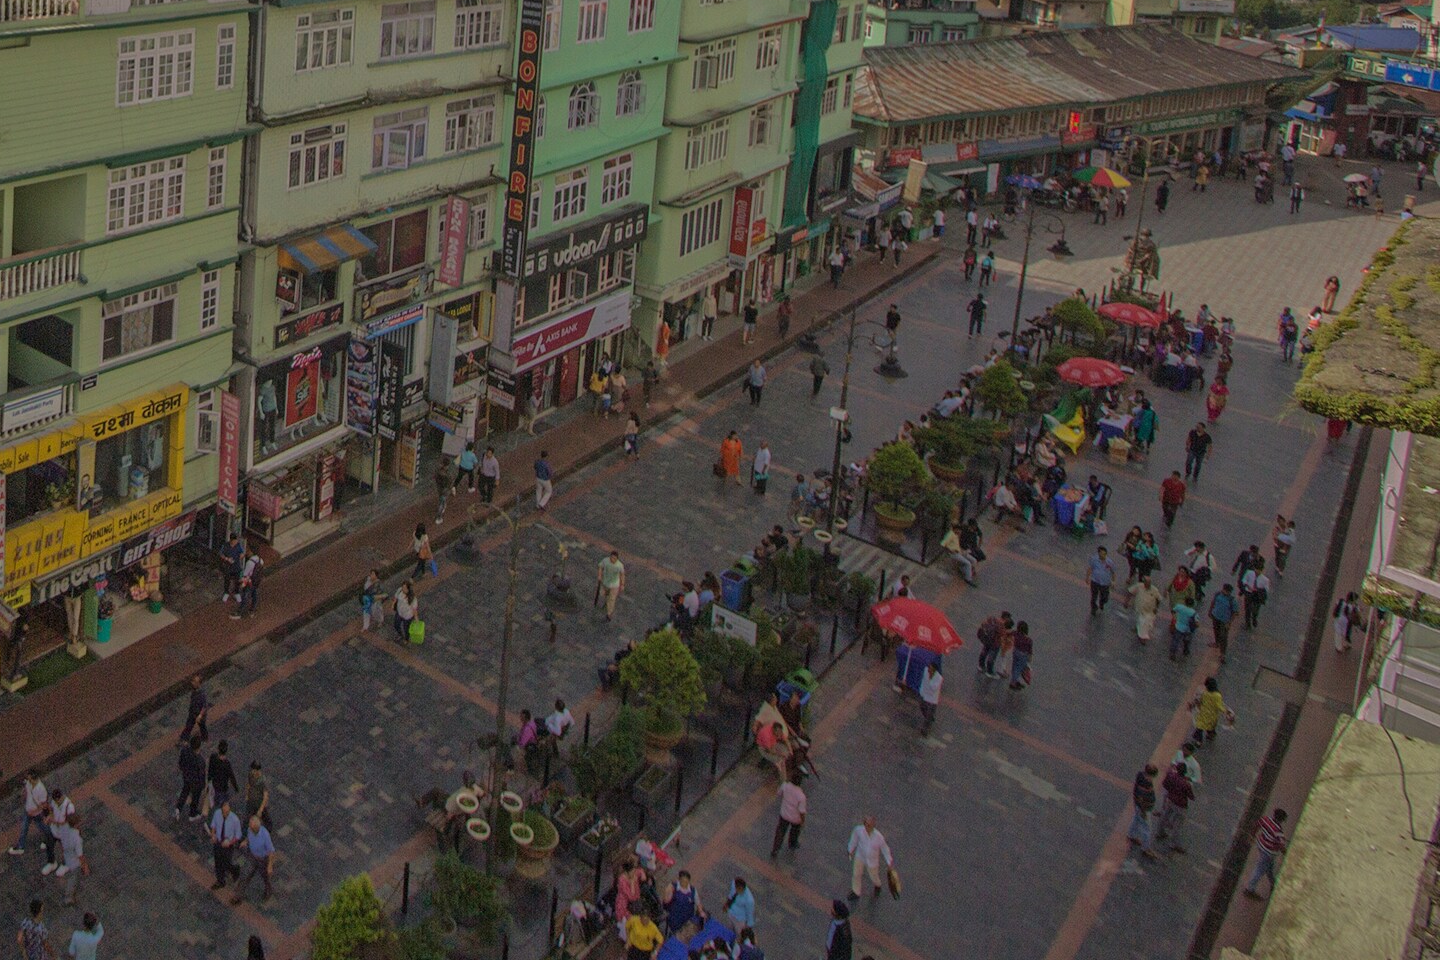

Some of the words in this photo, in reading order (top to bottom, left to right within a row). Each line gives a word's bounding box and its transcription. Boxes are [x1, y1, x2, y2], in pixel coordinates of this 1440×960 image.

[509, 30, 537, 222] BONFIRE
[504, 234, 514, 268] FLOOR
[546, 330, 560, 343] AXIS
[561, 322, 578, 337] BANK
[18, 451, 30, 464] Sale
[223, 421, 235, 499] OPTICAL
[83, 523, 113, 546] CORNING
[118, 508, 146, 529] FRANCE
[152, 494, 182, 514] OPTICAL
[123, 539, 154, 566] GIFT
[154, 521, 191, 550] SHOP
[37, 577, 69, 603] The
[71, 554, 113, 587] Craft
